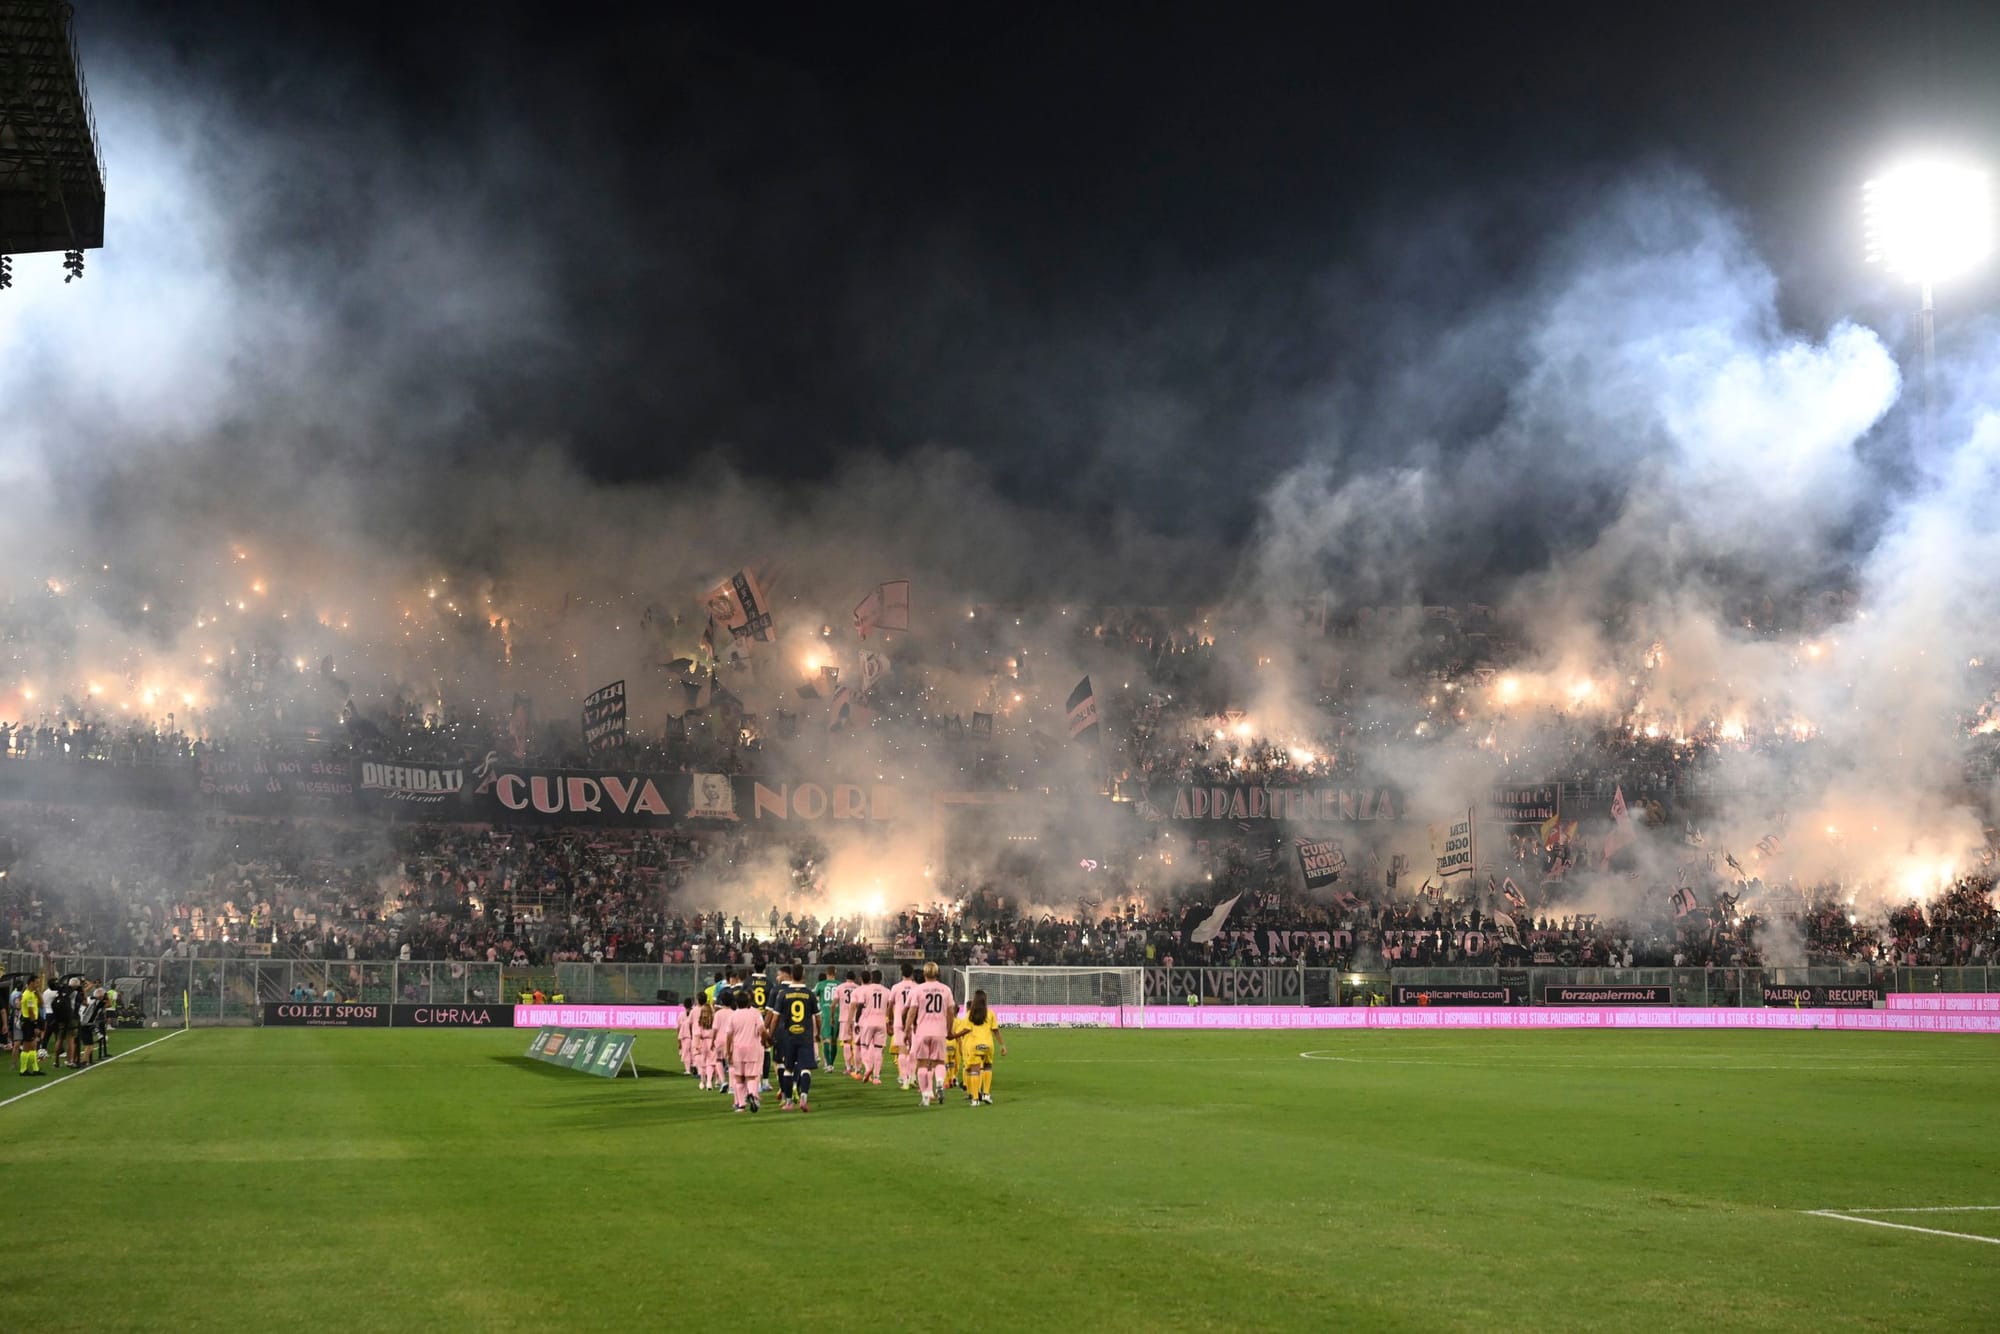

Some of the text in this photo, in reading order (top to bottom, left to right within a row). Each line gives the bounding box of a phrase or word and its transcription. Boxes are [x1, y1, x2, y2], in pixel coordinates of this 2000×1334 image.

[362, 762, 464, 790] DIFFIDATI
[384, 791, 445, 803] Palermo
[496, 773, 670, 815] CURVA
[1172, 787, 1396, 820] APPARTENENZA
[1207, 970, 1298, 1000] VECCHIO
[754, 987, 766, 1006] 6
[873, 993, 882, 1008] 11
[1561, 989, 1656, 1002] forzapalermo.it
[1764, 989, 1878, 1001] PALERMO RECUPERI
[925, 993, 942, 1013] 20
[278, 1005, 377, 1018] COLET SPOSI
[517, 1010, 527, 1024] LA
[530, 1010, 558, 1024] NUOVA
[560, 1010, 608, 1024] COLLEZIONE
[616, 1010, 664, 1024] DISPONIBILE
[668, 1010, 677, 1024] IN
[791, 1000, 805, 1024] 9
[1369, 1012, 1377, 1024] LA
[1379, 1012, 1399, 1024] NUOVA
[1402, 1012, 1437, 1024] COLLEZIONE
[1445, 1012, 1482, 1024] DISPONIBILE
[1493, 1012, 1512, 1024] STORE
[1530, 1012, 1600, 1024] STORE.PALERMOFC.COM
[1606, 1013, 1613, 1024] LA
[1727, 1013, 1748, 1024] STORE
